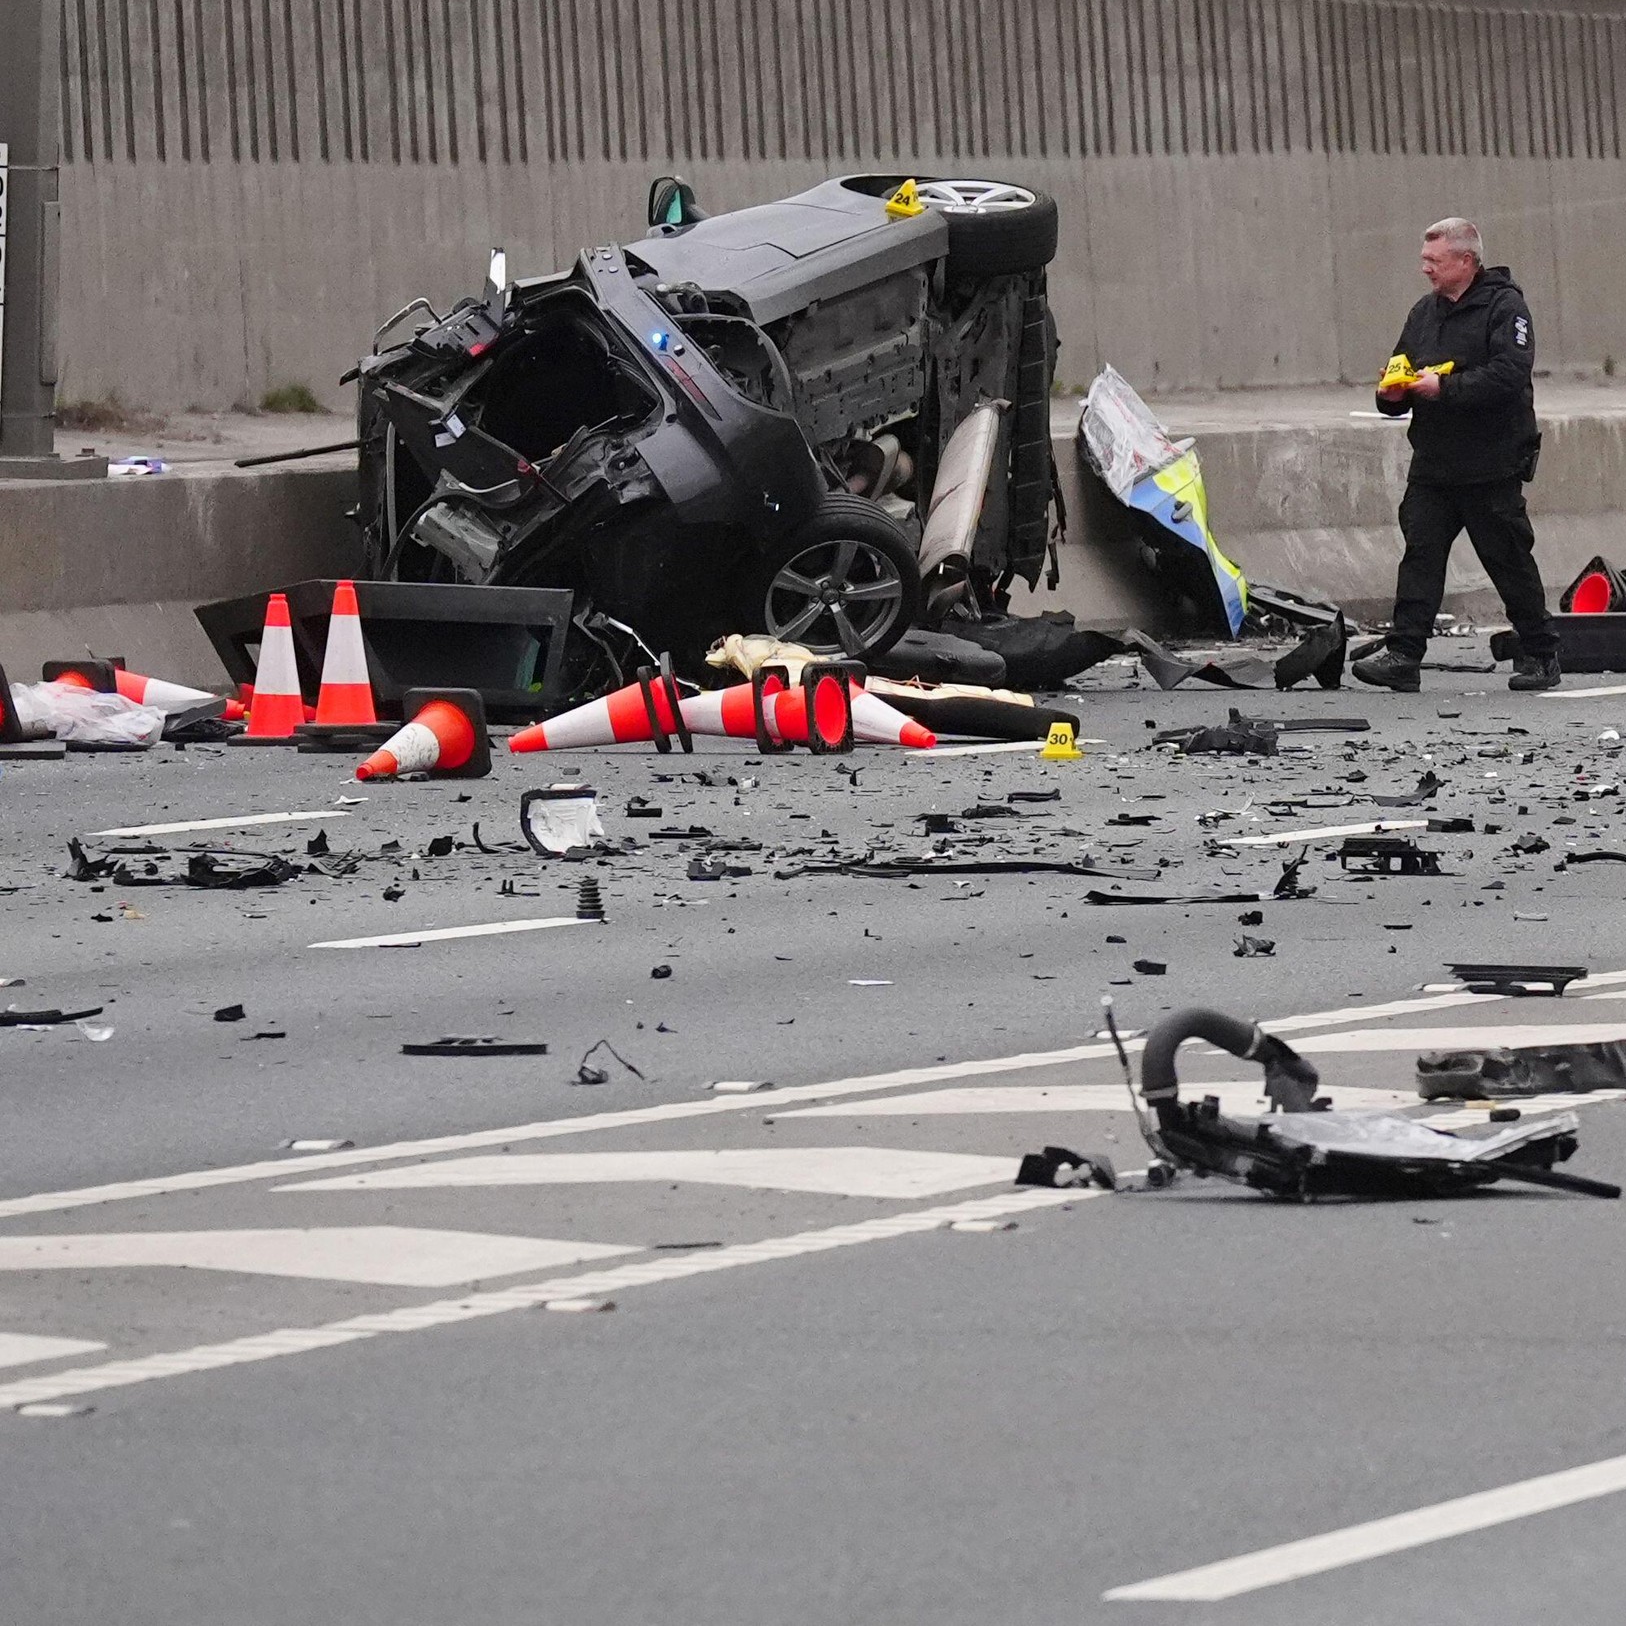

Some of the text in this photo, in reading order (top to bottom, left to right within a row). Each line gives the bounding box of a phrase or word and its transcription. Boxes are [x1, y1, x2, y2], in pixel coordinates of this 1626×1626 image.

[895, 192, 910, 206] 24
[1388, 363, 1401, 374] 25
[1050, 733, 1068, 745] 30
